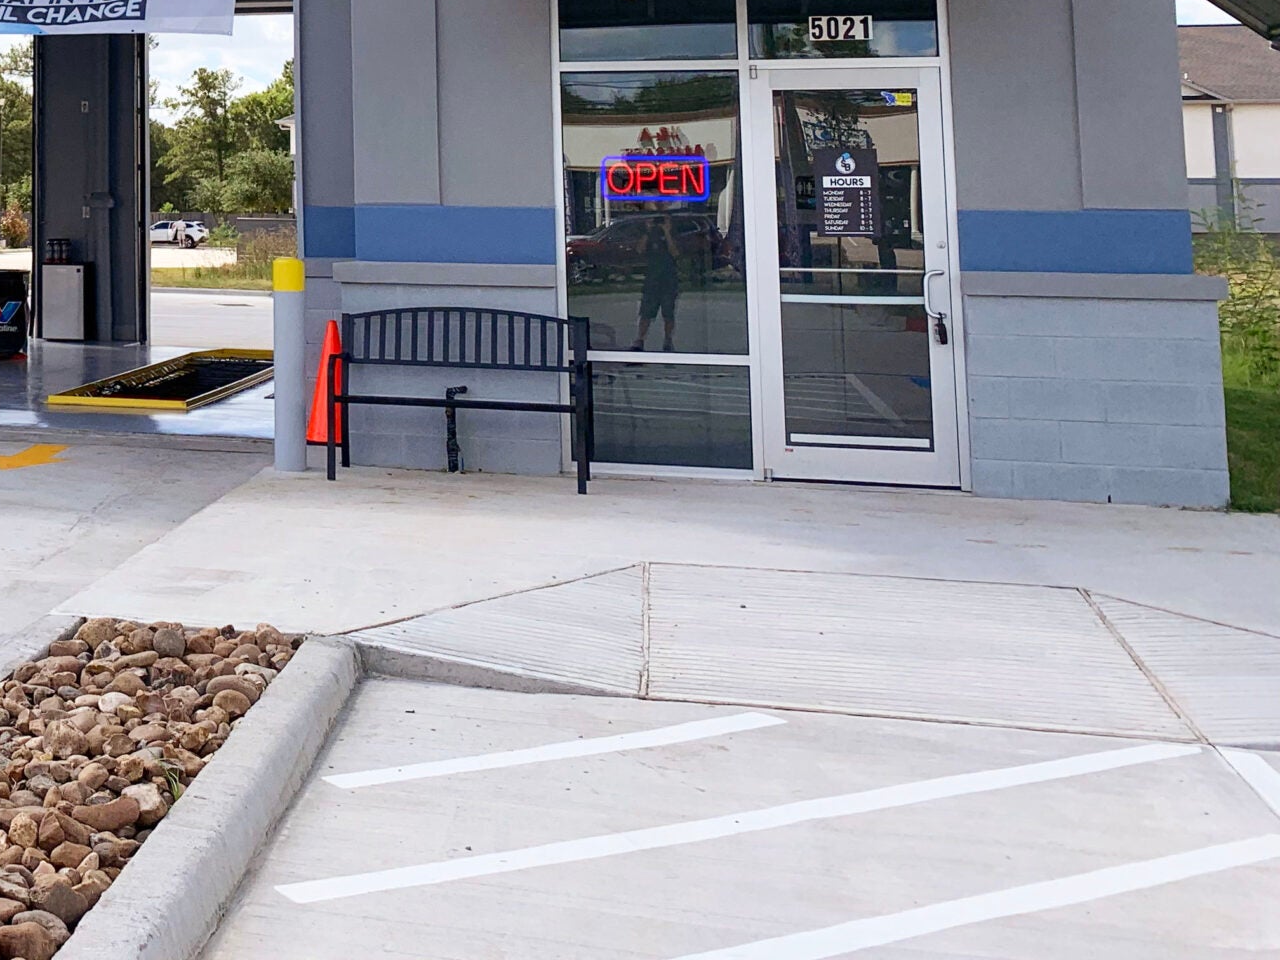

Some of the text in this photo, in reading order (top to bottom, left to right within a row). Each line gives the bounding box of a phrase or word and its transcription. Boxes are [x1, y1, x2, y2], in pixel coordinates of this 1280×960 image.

[811, 16, 869, 39] 5021
[607, 162, 705, 195] OPEN
[830, 178, 864, 186] HOURS
